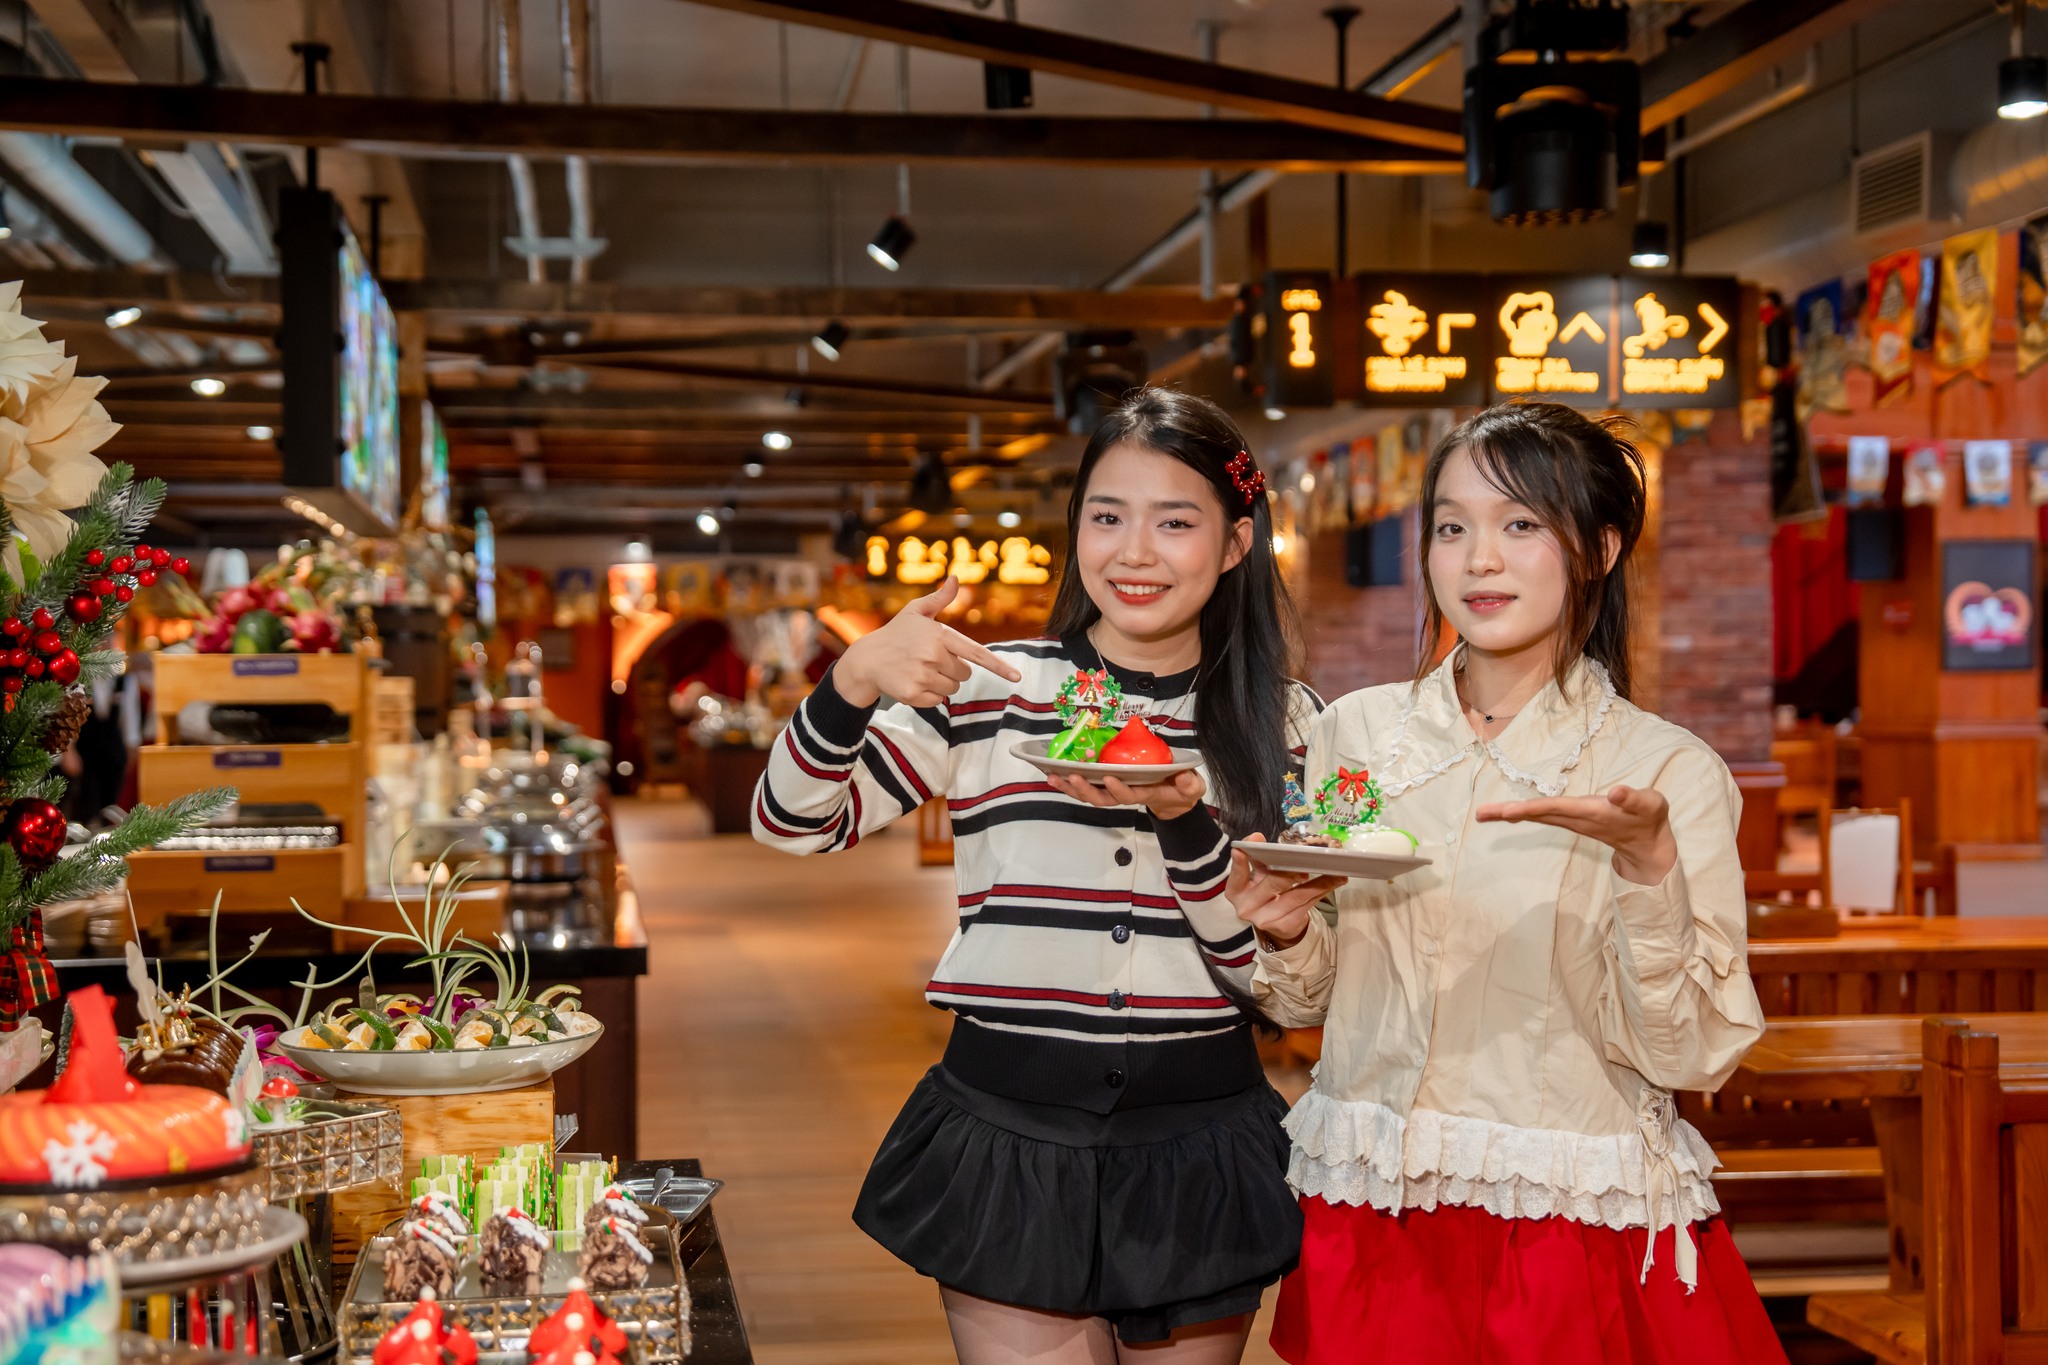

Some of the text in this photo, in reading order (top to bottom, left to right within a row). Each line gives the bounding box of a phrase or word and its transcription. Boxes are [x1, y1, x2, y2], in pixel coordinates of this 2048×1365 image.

[1122, 700, 1145, 711] Merry
[1334, 807, 1358, 820] Merry
[1324, 814, 1360, 826] Christma
